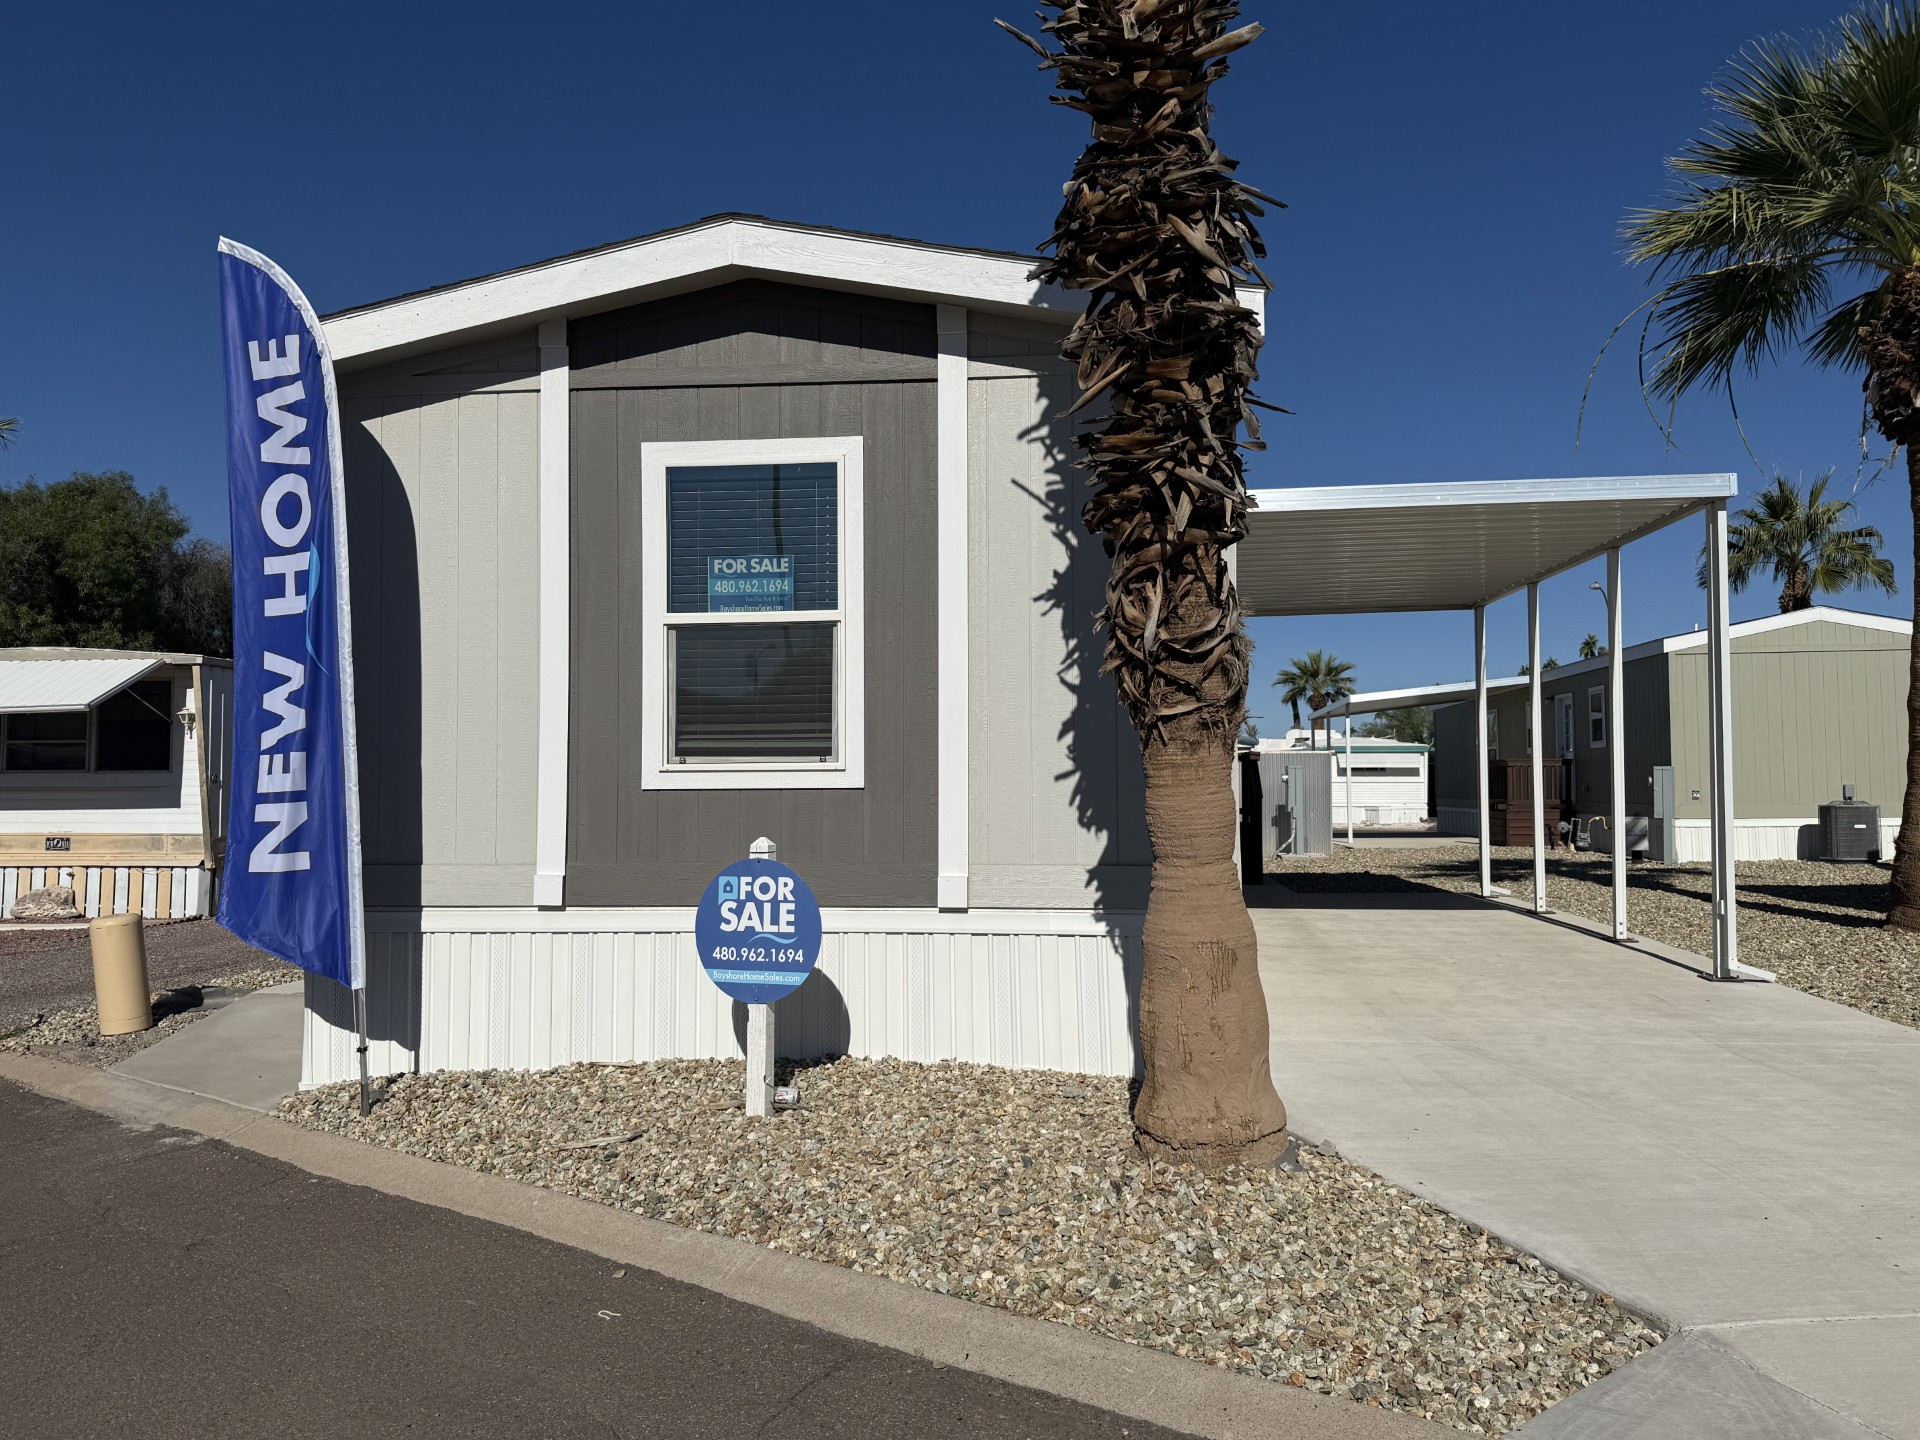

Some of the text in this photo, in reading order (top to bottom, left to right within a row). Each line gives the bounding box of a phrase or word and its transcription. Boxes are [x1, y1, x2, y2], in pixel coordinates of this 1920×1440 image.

[714, 558, 789, 574] FOR SALE
[714, 579, 789, 593] 480.962.1694
[248, 334, 311, 872] NEW HOME
[739, 876, 795, 901] FOR
[719, 901, 795, 933] SALE
[712, 946, 804, 963] 480.962.1694
[713, 970, 800, 983] BayshoreHomeSales.com
